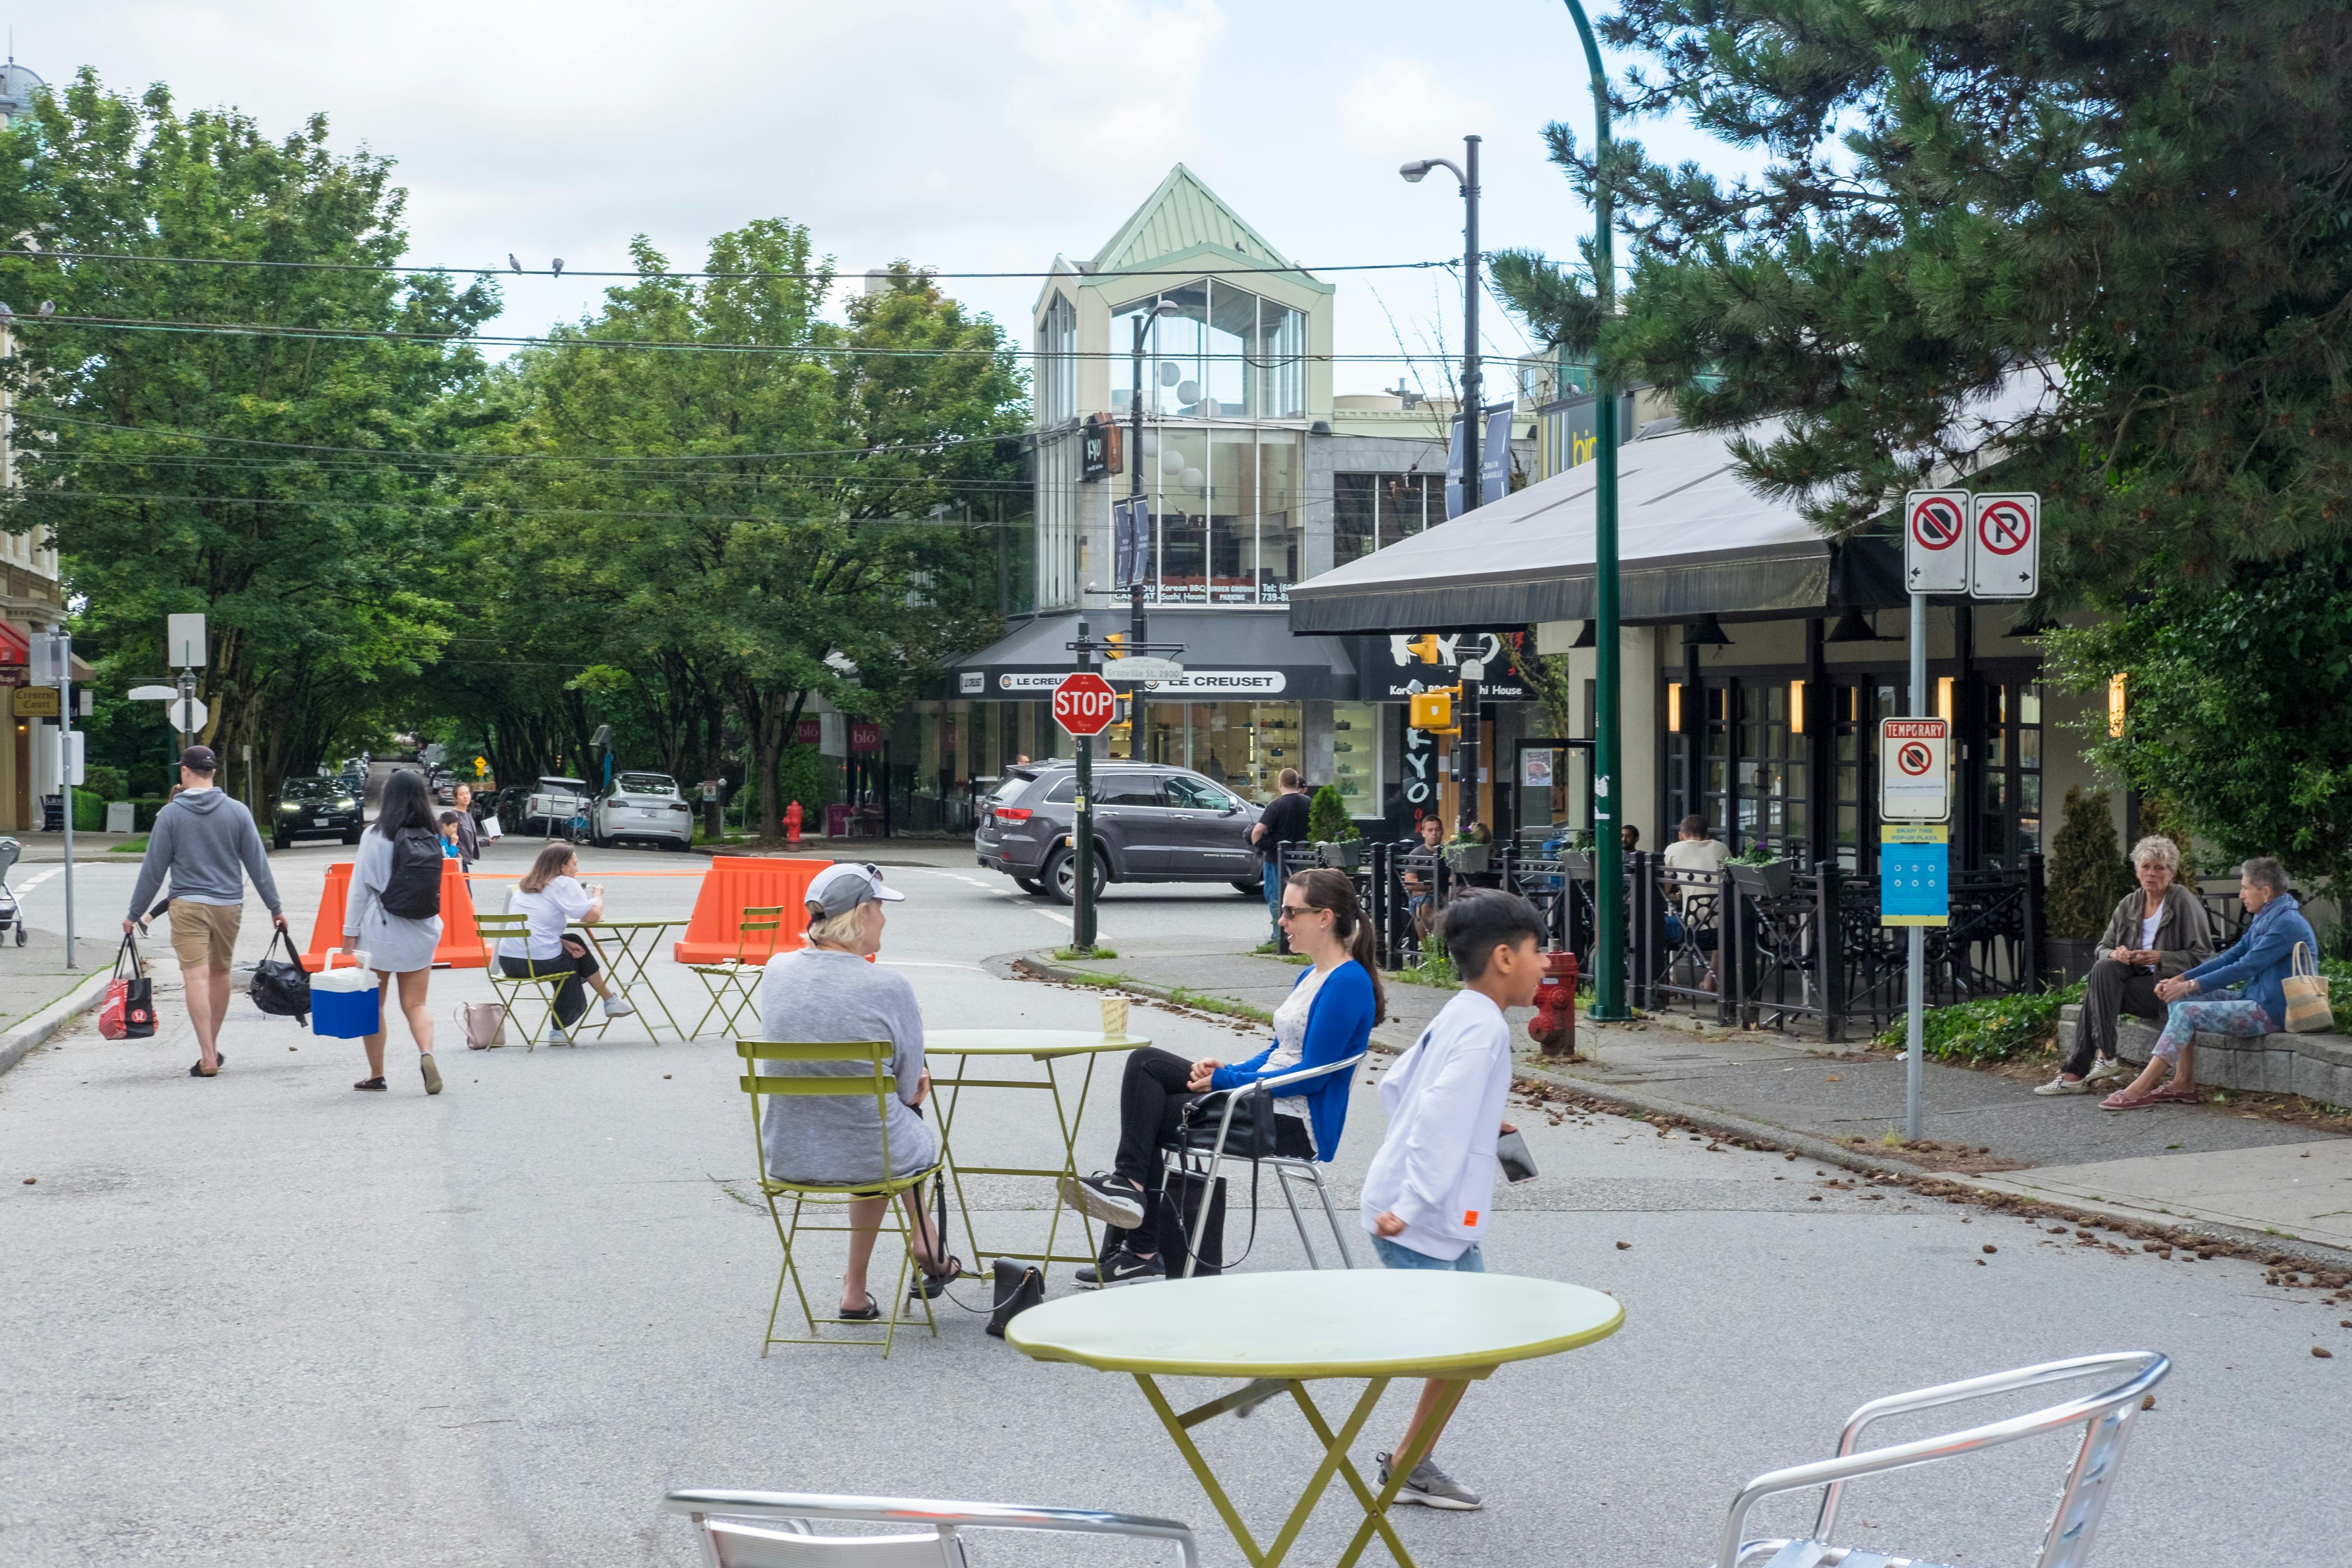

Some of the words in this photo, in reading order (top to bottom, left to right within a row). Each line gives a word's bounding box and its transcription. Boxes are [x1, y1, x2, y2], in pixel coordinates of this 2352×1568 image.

[1482, 470, 1503, 479] RANVILLE
[1189, 585, 1206, 593] BBQ
[1262, 584, 1277, 592] Tel:
[1107, 669, 1143, 677] Granville
[1194, 677, 1273, 686] CREUSET
[1390, 686, 1424, 695] Kore
[1492, 685, 1522, 695] House
[23, 700, 50, 708] Court
[1056, 691, 1113, 716] STOP
[1887, 724, 1943, 736] TEMPORARY
